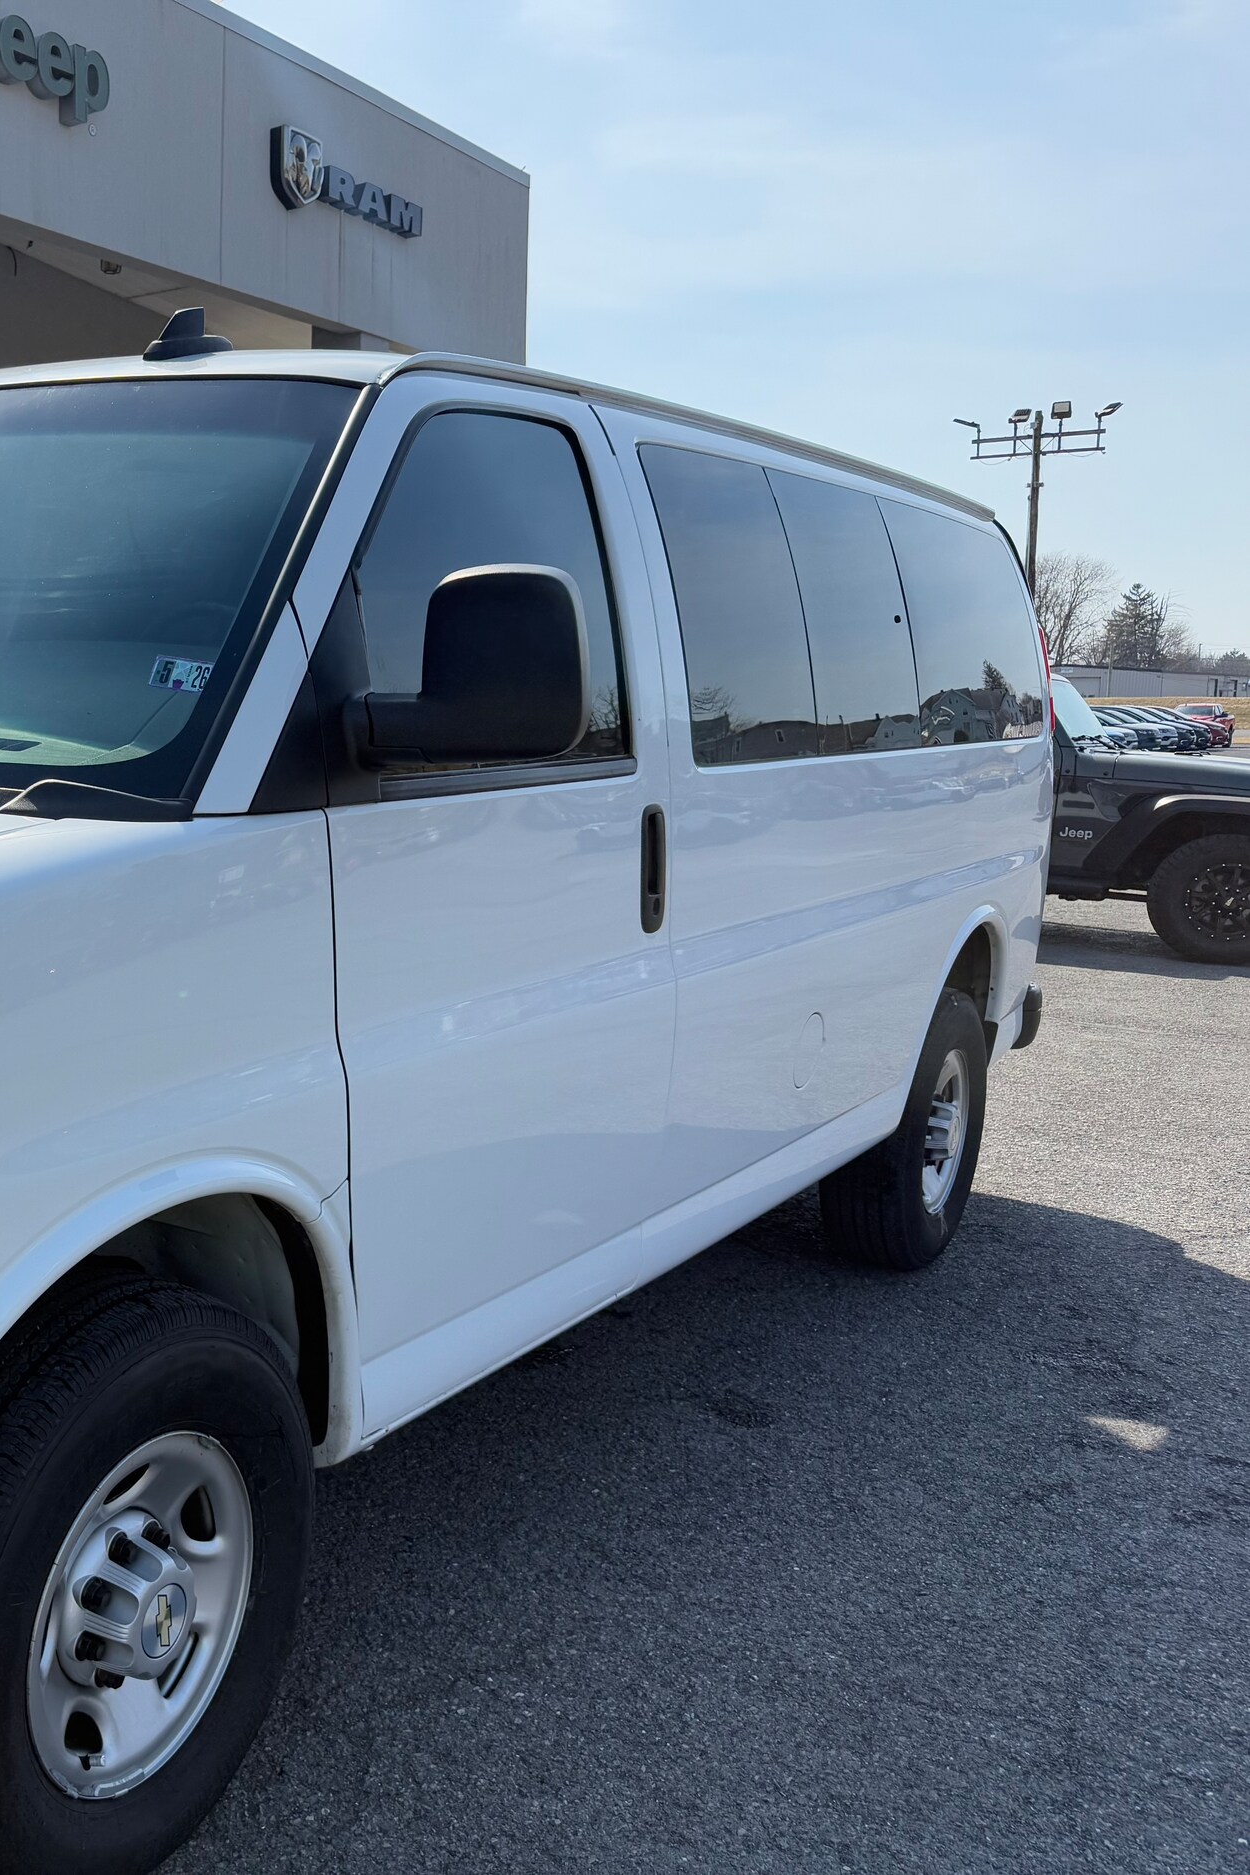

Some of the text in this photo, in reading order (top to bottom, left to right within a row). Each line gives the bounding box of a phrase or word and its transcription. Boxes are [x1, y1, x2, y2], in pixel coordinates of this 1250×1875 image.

[321, 165, 423, 239] RAM
[159, 660, 211, 689] 5 26
[1059, 827, 1093, 840] Jeep
